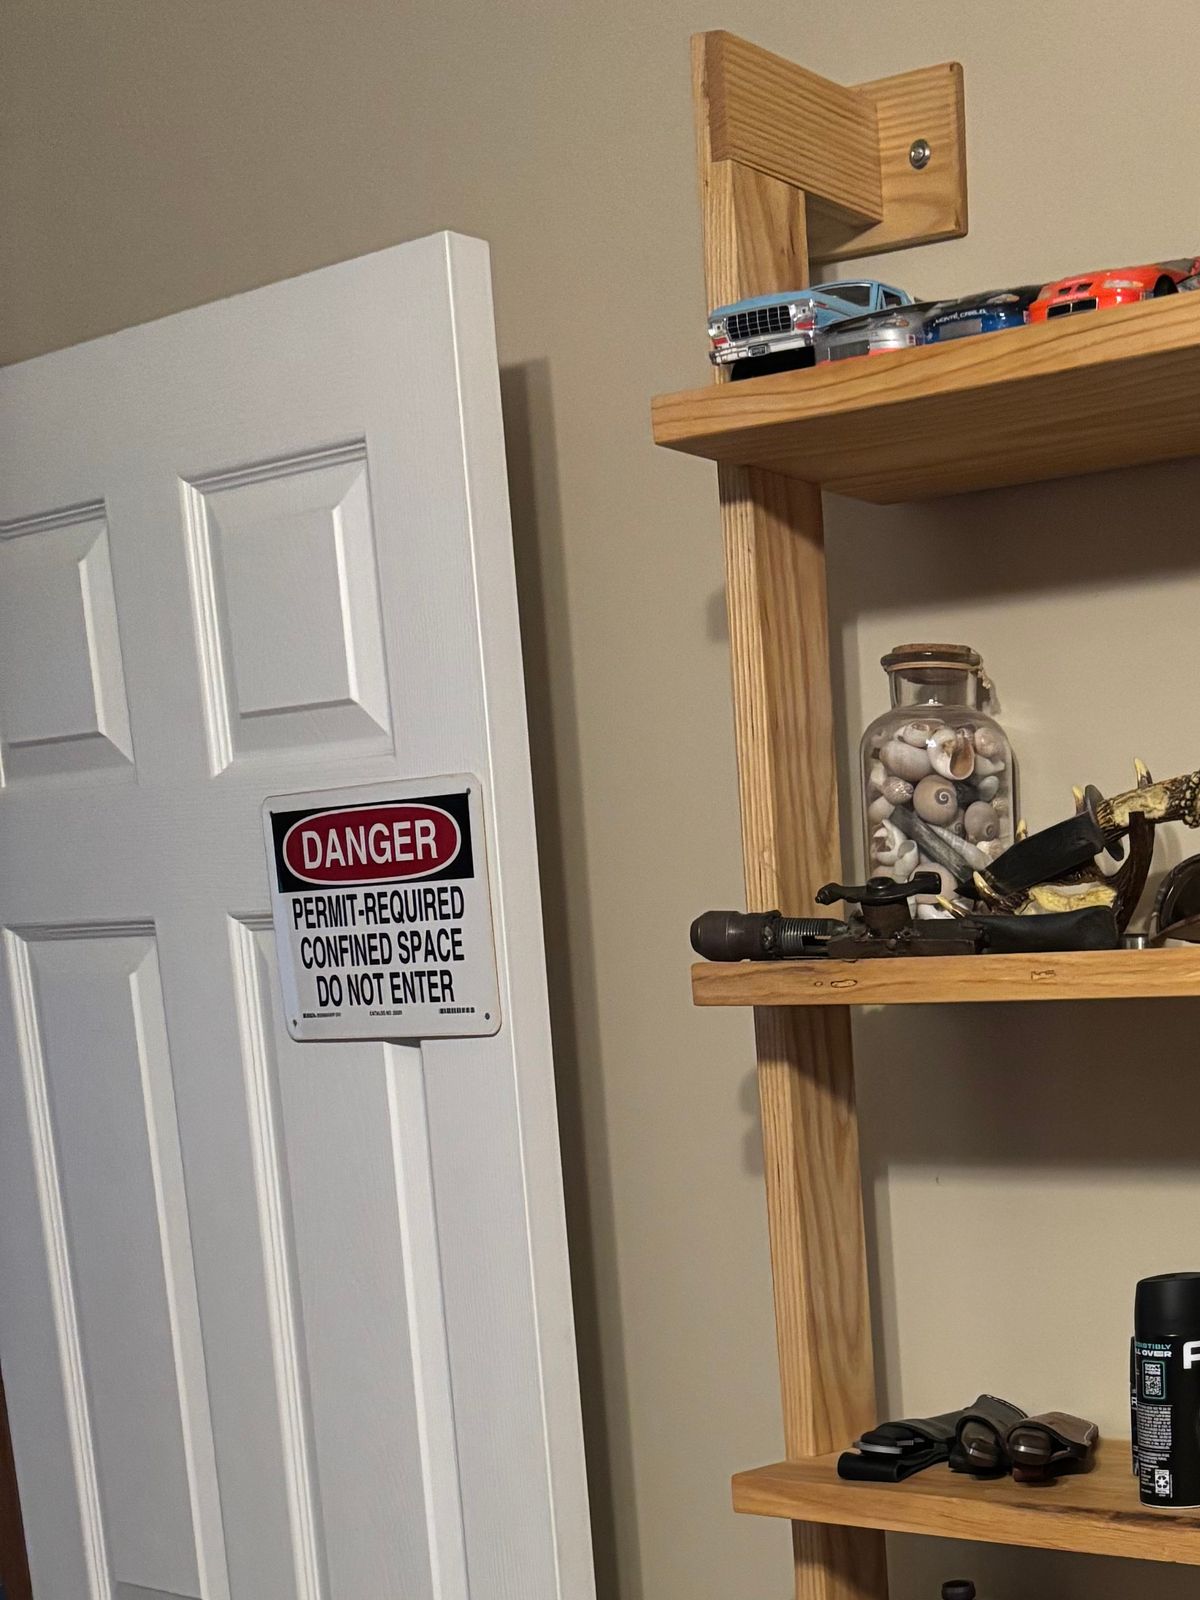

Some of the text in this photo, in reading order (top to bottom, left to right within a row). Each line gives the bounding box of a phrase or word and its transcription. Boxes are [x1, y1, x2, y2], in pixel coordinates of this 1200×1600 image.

[301, 819, 438, 870] DANGER
[292, 886, 465, 929] PERMIT-REQUIRED
[301, 928, 465, 969] CONFINED SPACE
[316, 969, 455, 1007] DO NOT ENTER
[1142, 1349, 1172, 1357] OVER
